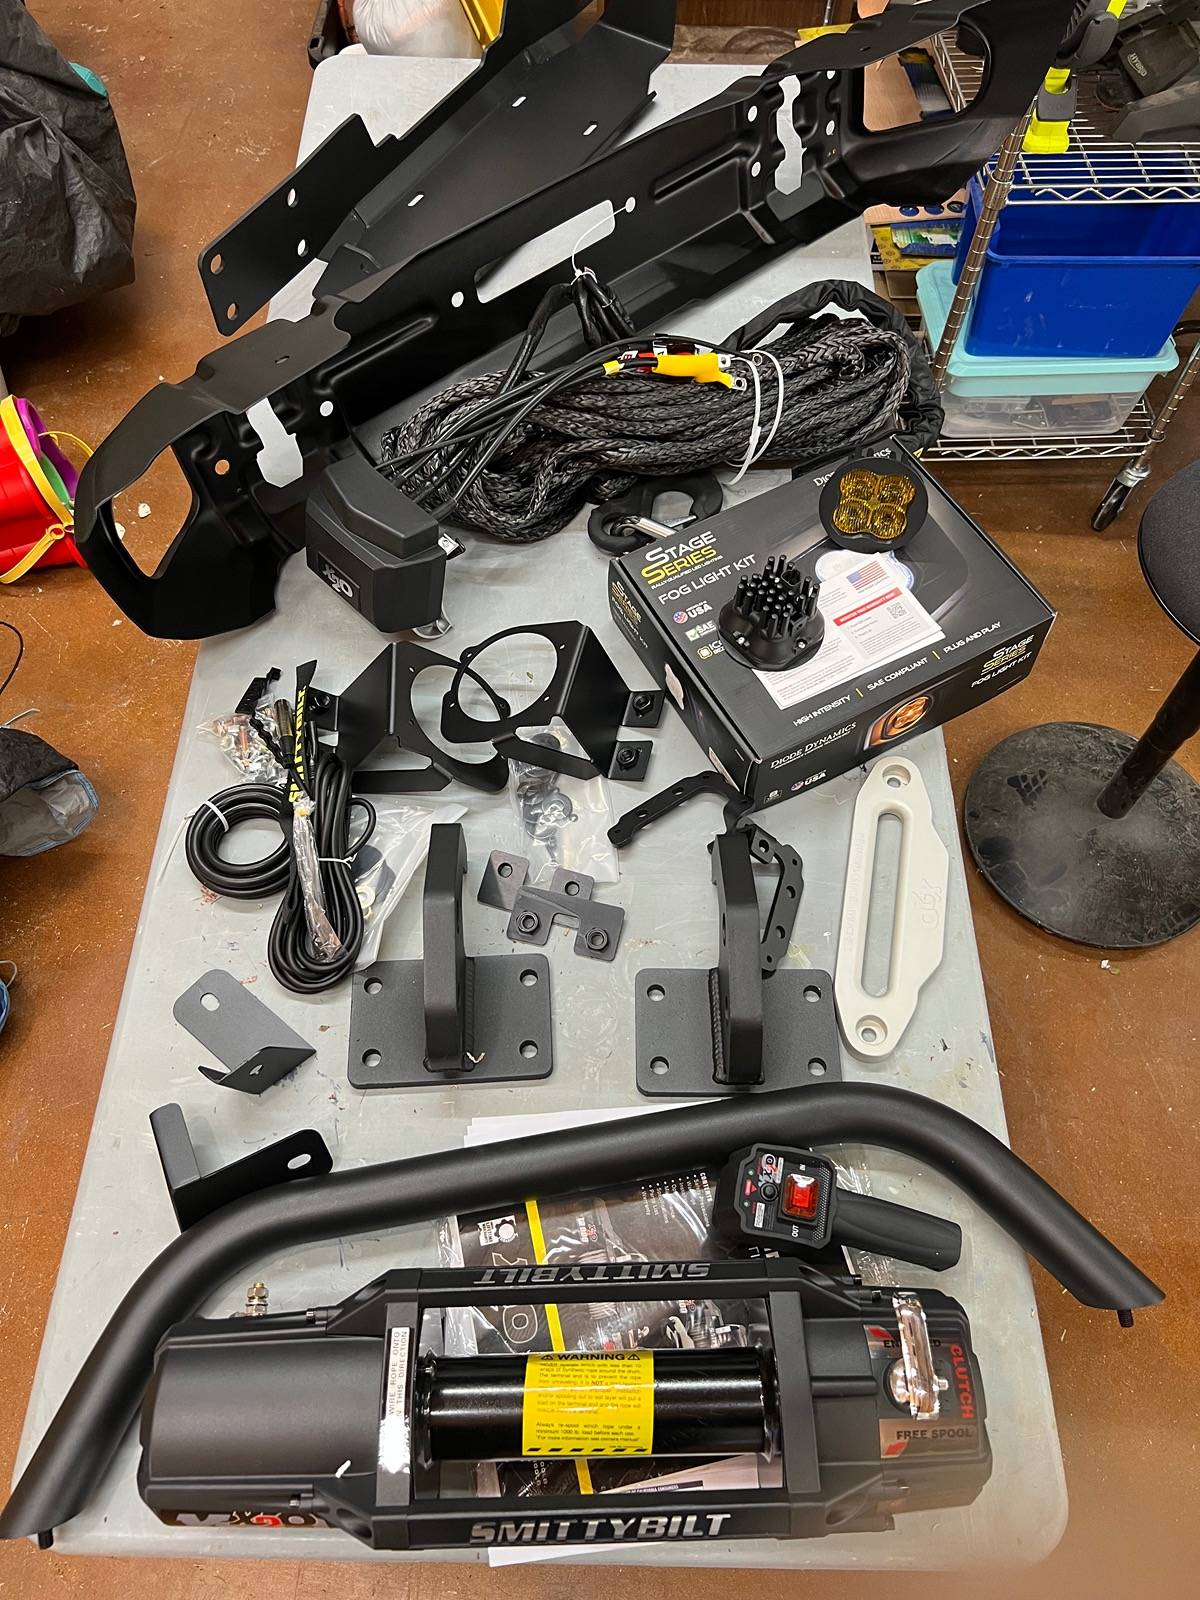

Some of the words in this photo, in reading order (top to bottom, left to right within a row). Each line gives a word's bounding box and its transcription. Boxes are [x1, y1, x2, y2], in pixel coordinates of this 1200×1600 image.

[645, 531, 717, 562] STAGE
[641, 546, 717, 585] SERIES
[658, 585, 692, 605] FOG
[695, 565, 732, 590] LIGHT
[733, 554, 756, 571] KIT
[687, 604, 713, 618] USA
[696, 620, 715, 634] SAE
[943, 639, 966, 654] PLUG
[965, 631, 982, 643] AND
[980, 621, 1001, 635] PLAY
[981, 645, 1026, 672] SERIES
[993, 635, 1034, 657] STAGE
[867, 678, 886, 691] SAE
[884, 657, 929, 683] COMPLIANT
[971, 674, 991, 688] FOG
[992, 660, 1017, 677] LIGHT
[1018, 651, 1033, 663] KIT
[793, 713, 814, 727] HIGH
[812, 695, 851, 717] INTENSITY
[770, 749, 803, 769] DIODE
[804, 722, 857, 752] DYNAMICS
[804, 772, 827, 786] USA
[791, 1224, 799, 1237] OUT
[473, 1263, 711, 1285] SMITTYBILT
[398, 1331, 408, 1378] DIRECTION
[390, 1361, 398, 1386] ROPE
[951, 1344, 974, 1419] CLUTCH
[389, 1391, 397, 1416] WIRE
[896, 1430, 928, 1440] FREE
[931, 1427, 972, 1439] SPOOL
[469, 1513, 732, 1545] SMITTYBILT
